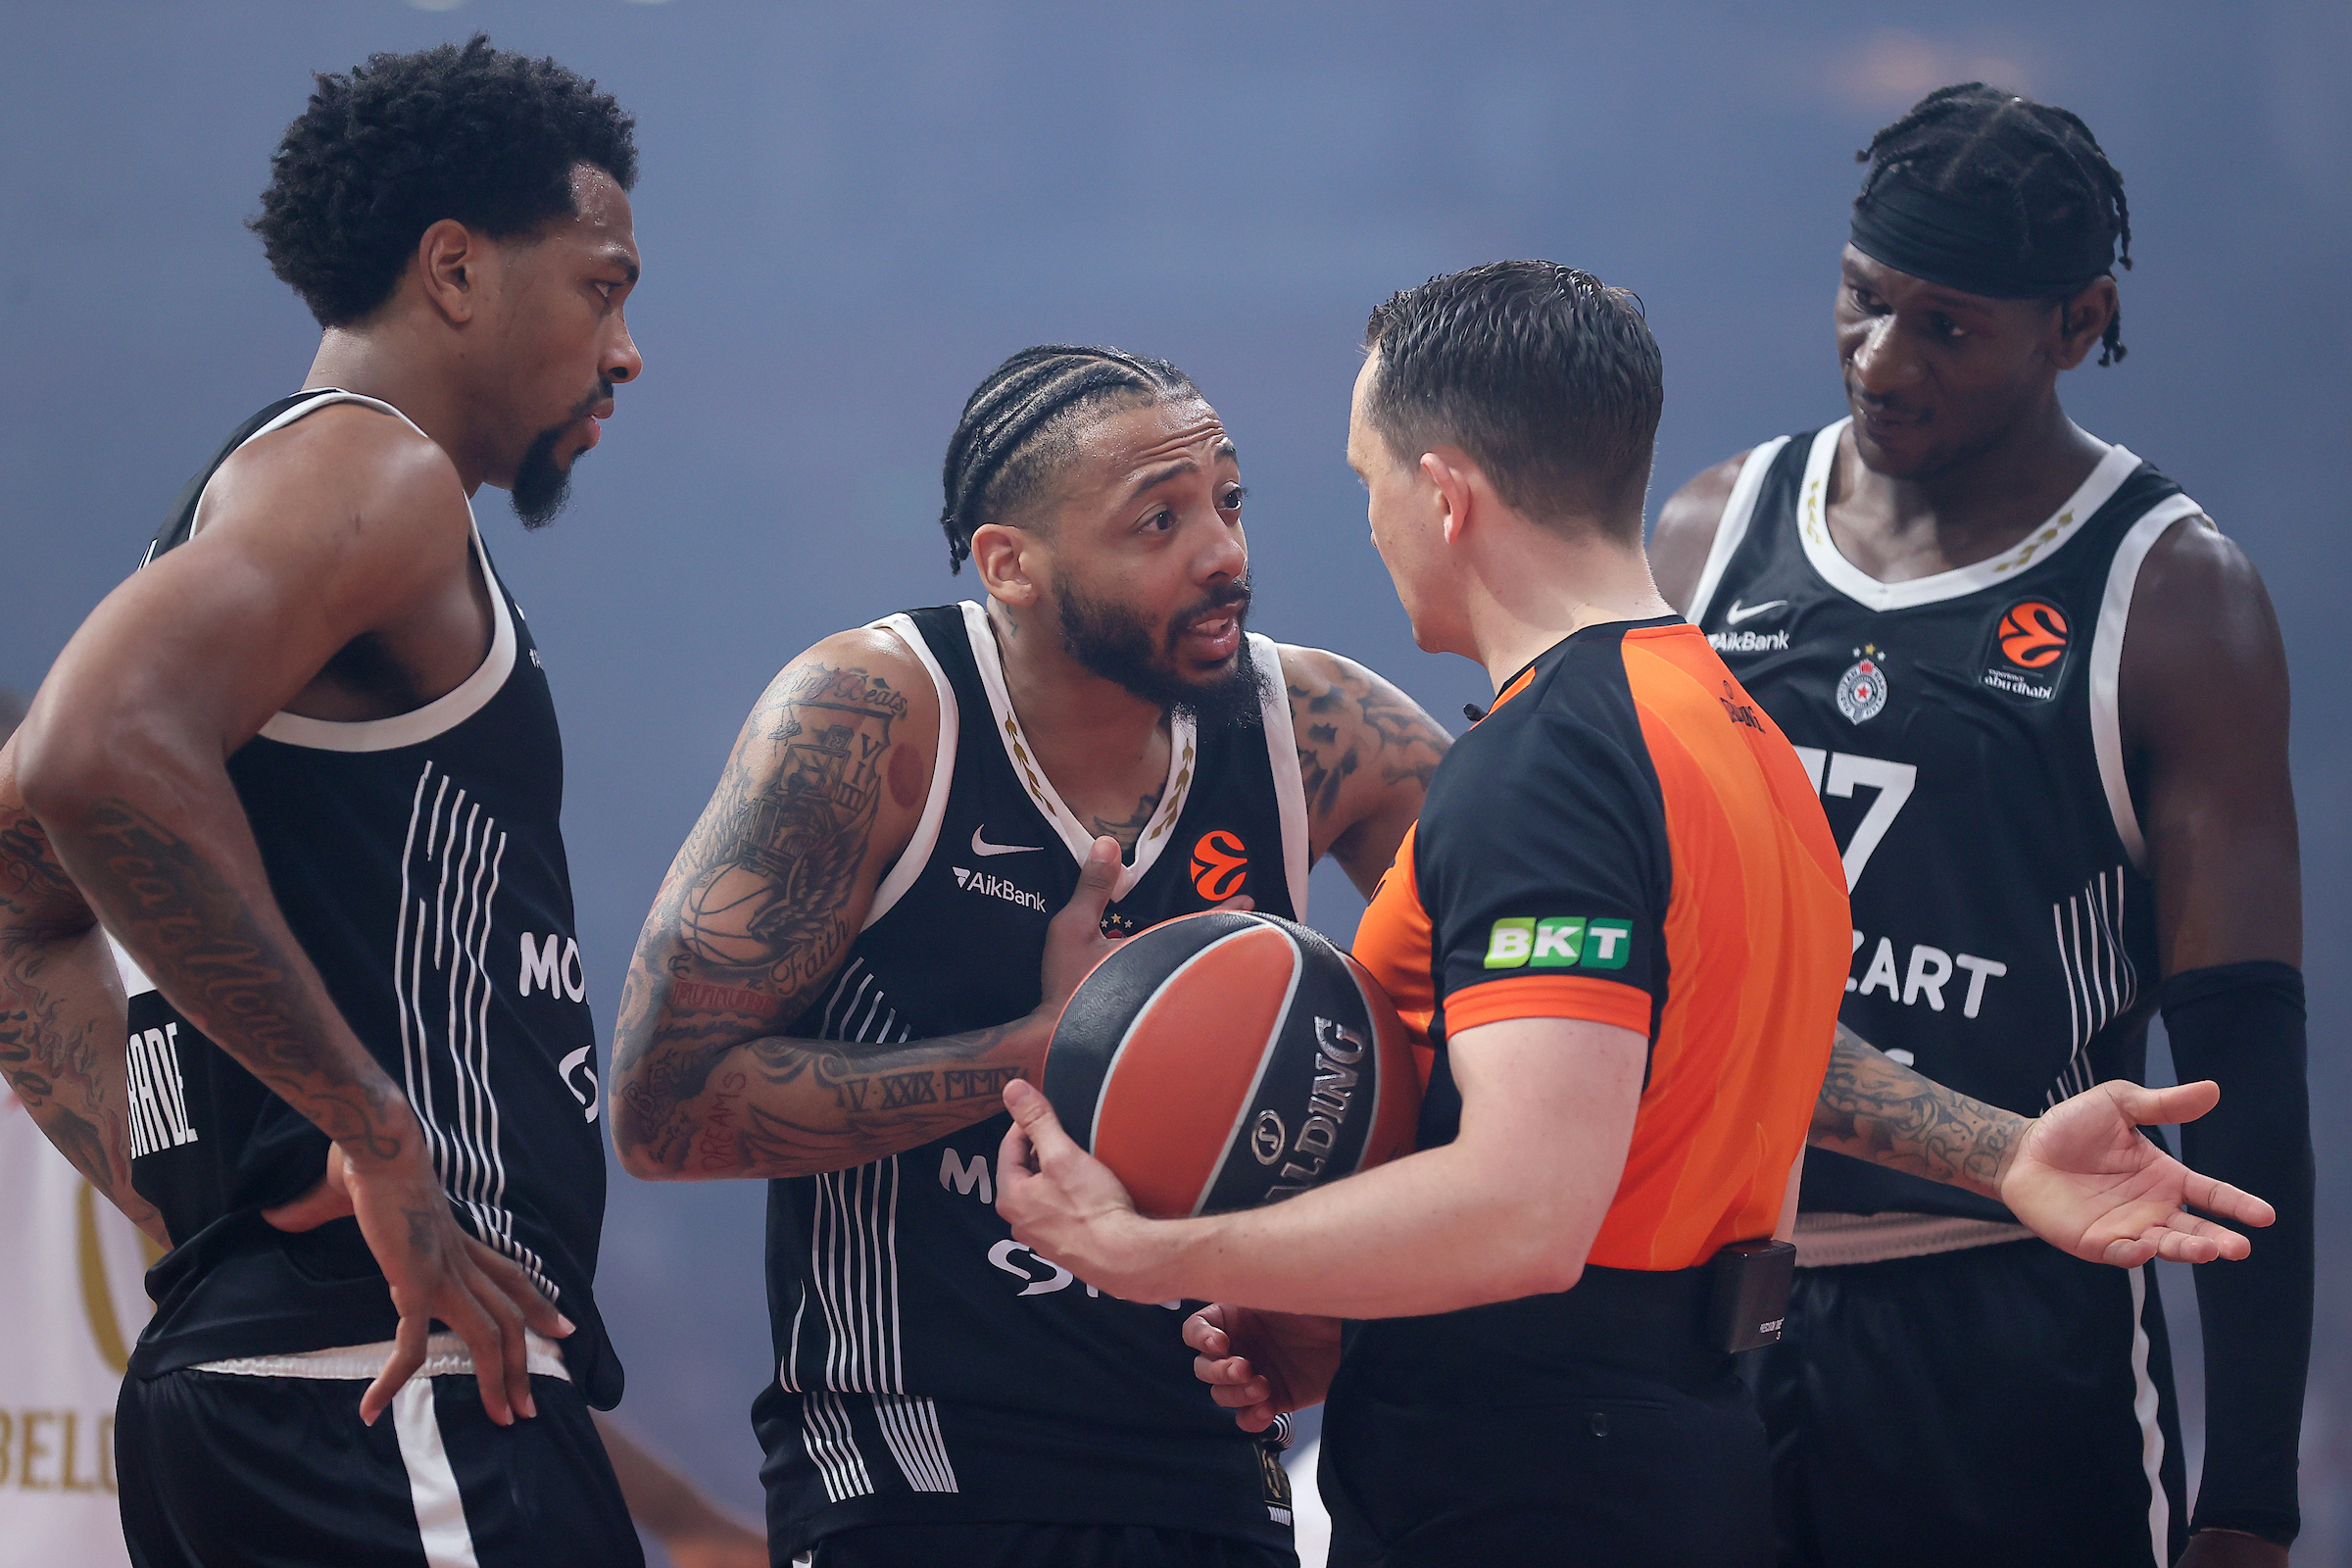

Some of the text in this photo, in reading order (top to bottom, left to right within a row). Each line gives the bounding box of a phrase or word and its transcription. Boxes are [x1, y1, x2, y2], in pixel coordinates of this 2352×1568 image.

[1714, 629, 1790, 652] AikBank
[1984, 675, 2053, 700] abu dhabi
[1792, 745, 1918, 897] 7
[966, 871, 1047, 913] AikBank
[1488, 925, 1629, 960] BKT
